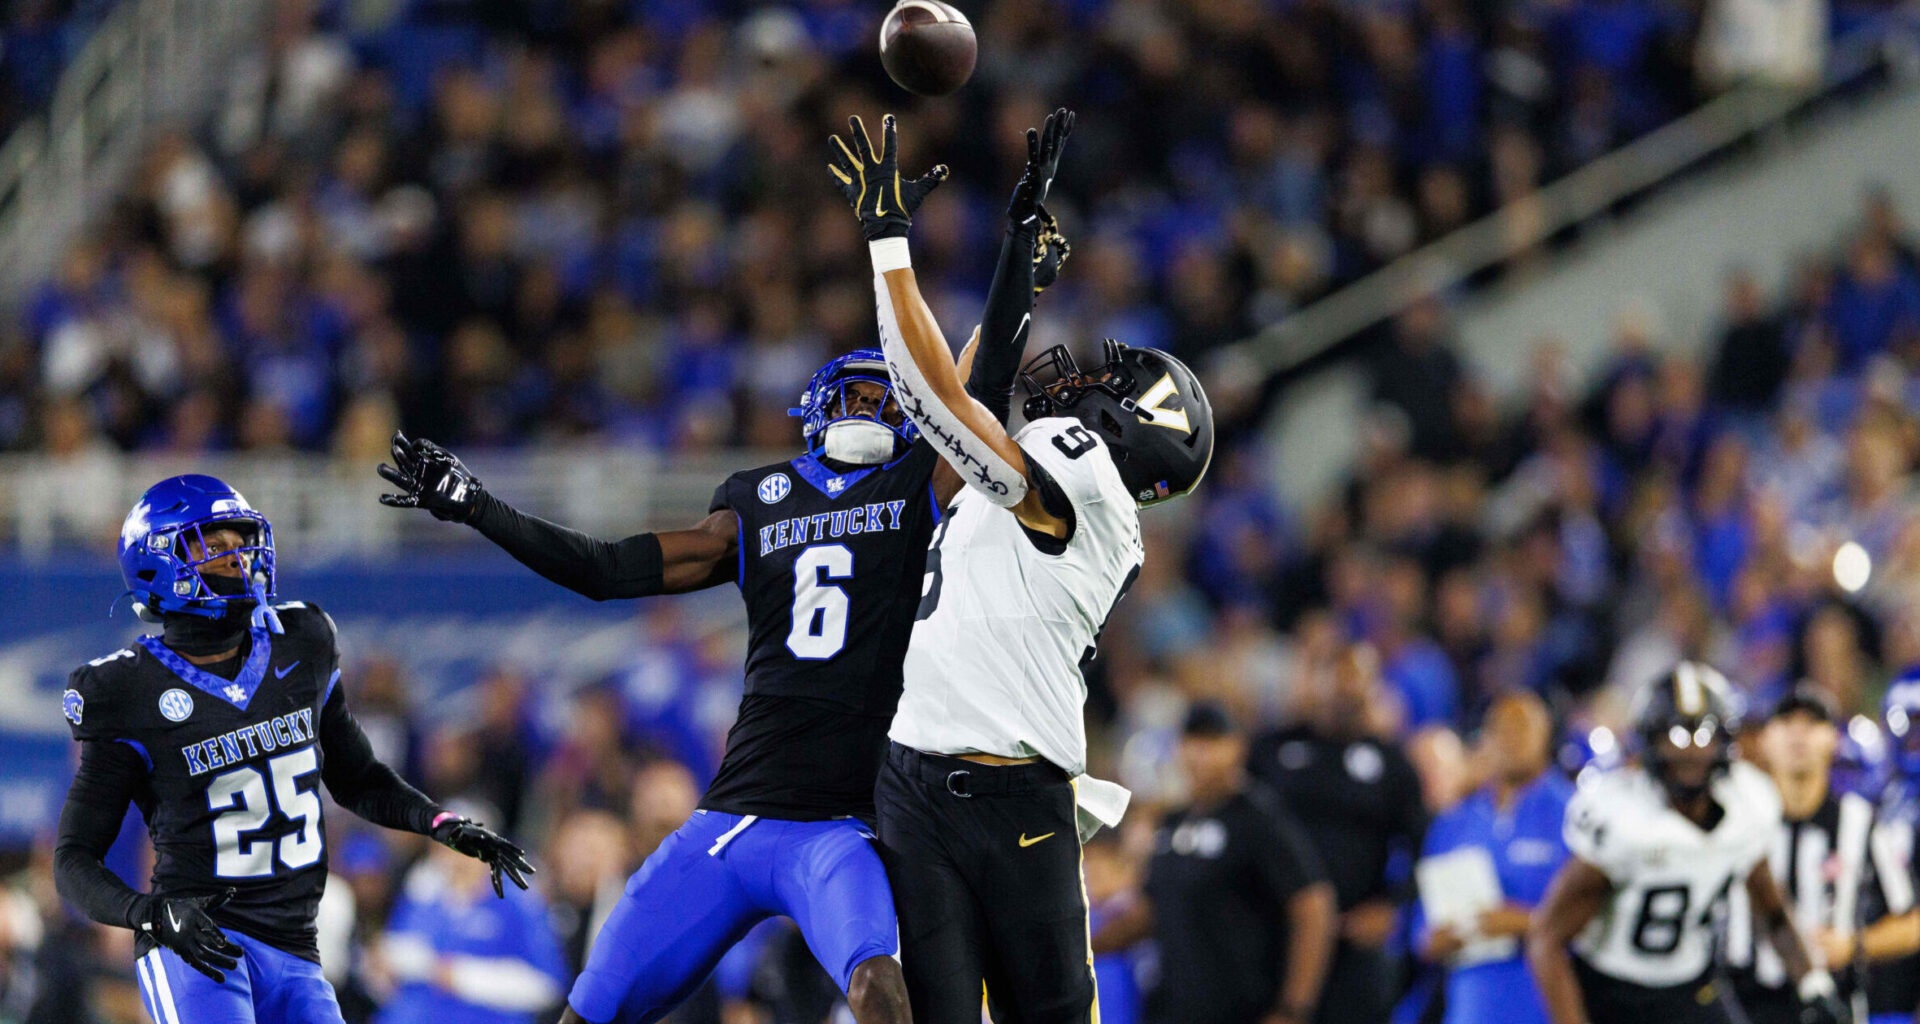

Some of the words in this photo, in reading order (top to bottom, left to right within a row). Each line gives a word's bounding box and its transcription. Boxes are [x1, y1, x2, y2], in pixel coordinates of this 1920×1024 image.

[1136, 371, 1192, 435] V
[760, 474, 790, 502] SEC
[759, 499, 906, 558] KENTUCKY
[784, 542, 855, 660] 6
[160, 690, 192, 721] SEC
[181, 707, 315, 776] KENTUCKY
[204, 744, 323, 879] 25
